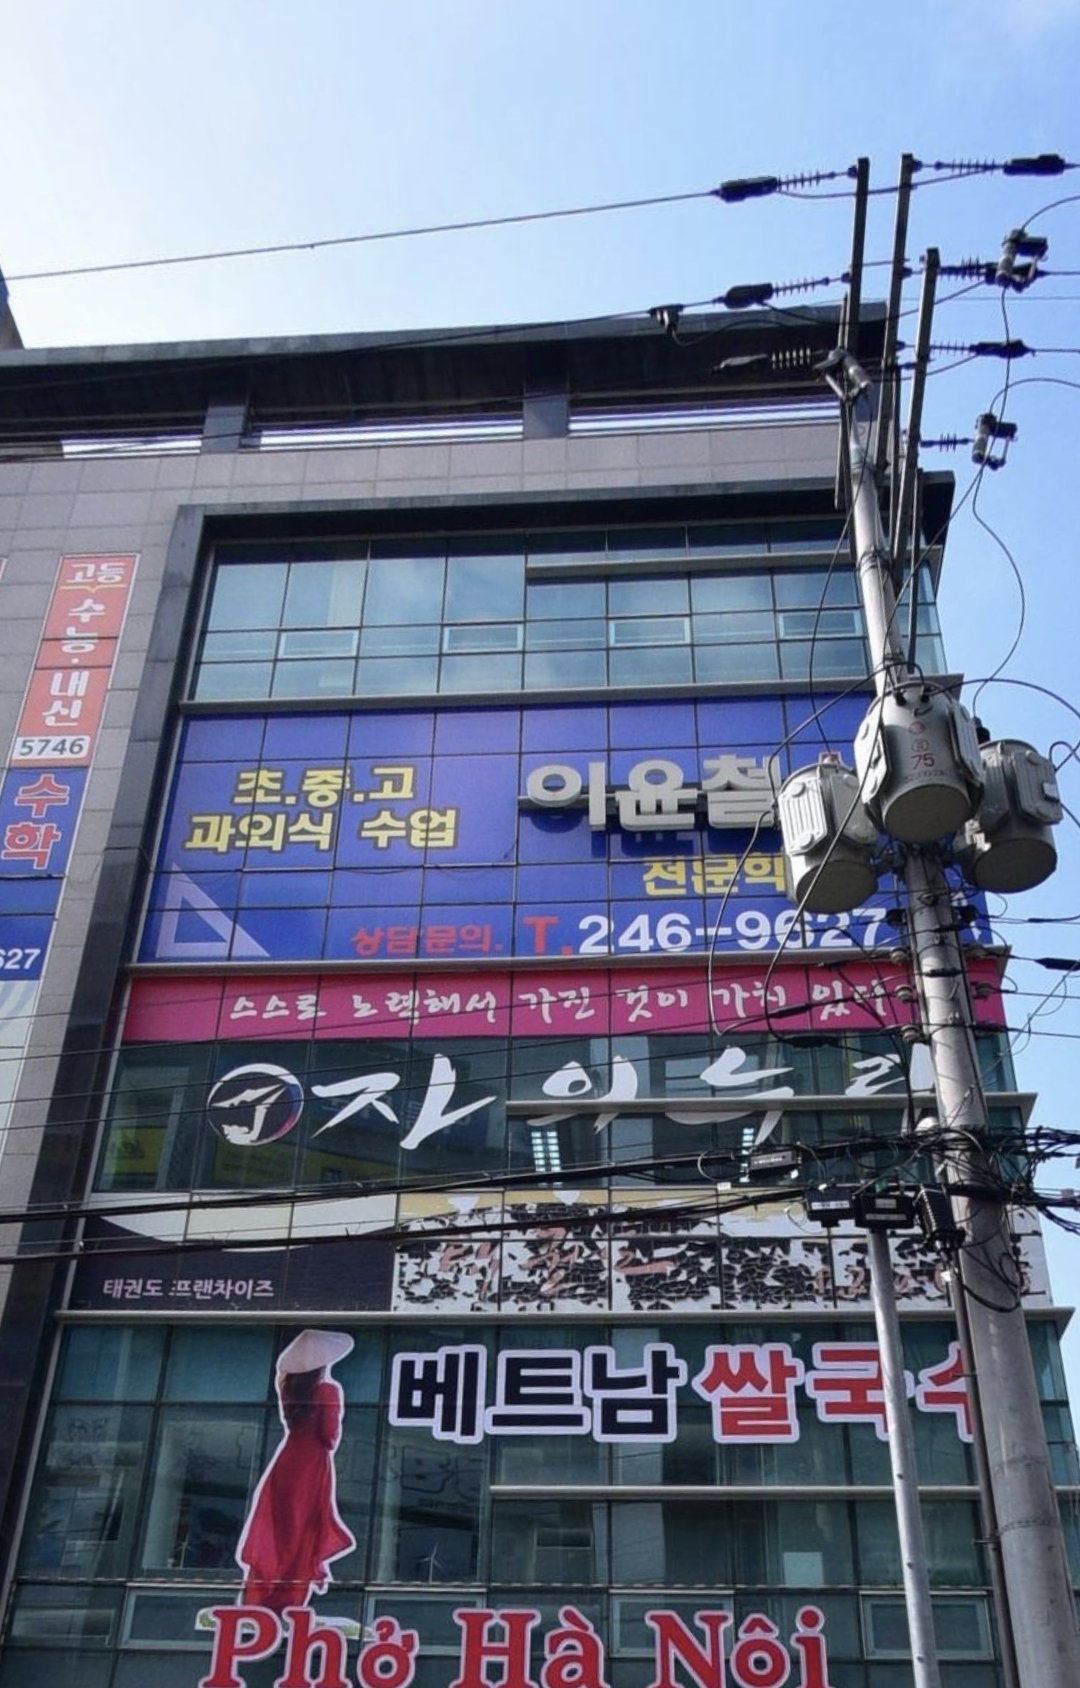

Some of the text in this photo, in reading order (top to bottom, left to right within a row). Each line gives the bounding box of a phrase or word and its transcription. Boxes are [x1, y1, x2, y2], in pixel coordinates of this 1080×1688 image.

[66, 562, 125, 584] 고등
[19, 737, 85, 757] 5746
[232, 766, 415, 808] 초.중.고
[526, 755, 781, 831] 이윤철
[1, 773, 70, 870] 수학
[184, 807, 459, 853] 과외식 수업
[230, 994, 327, 1020] 스스로
[351, 988, 497, 1025] 노력해서
[518, 987, 596, 1024] 가진
[615, 985, 688, 1022] 것이
[713, 982, 786, 1018] 가치
[103, 1278, 274, 1300] 태권도 프랜차이즈
[390, 1343, 687, 1444] 베트남
[450, 1605, 611, 1688] Hà
